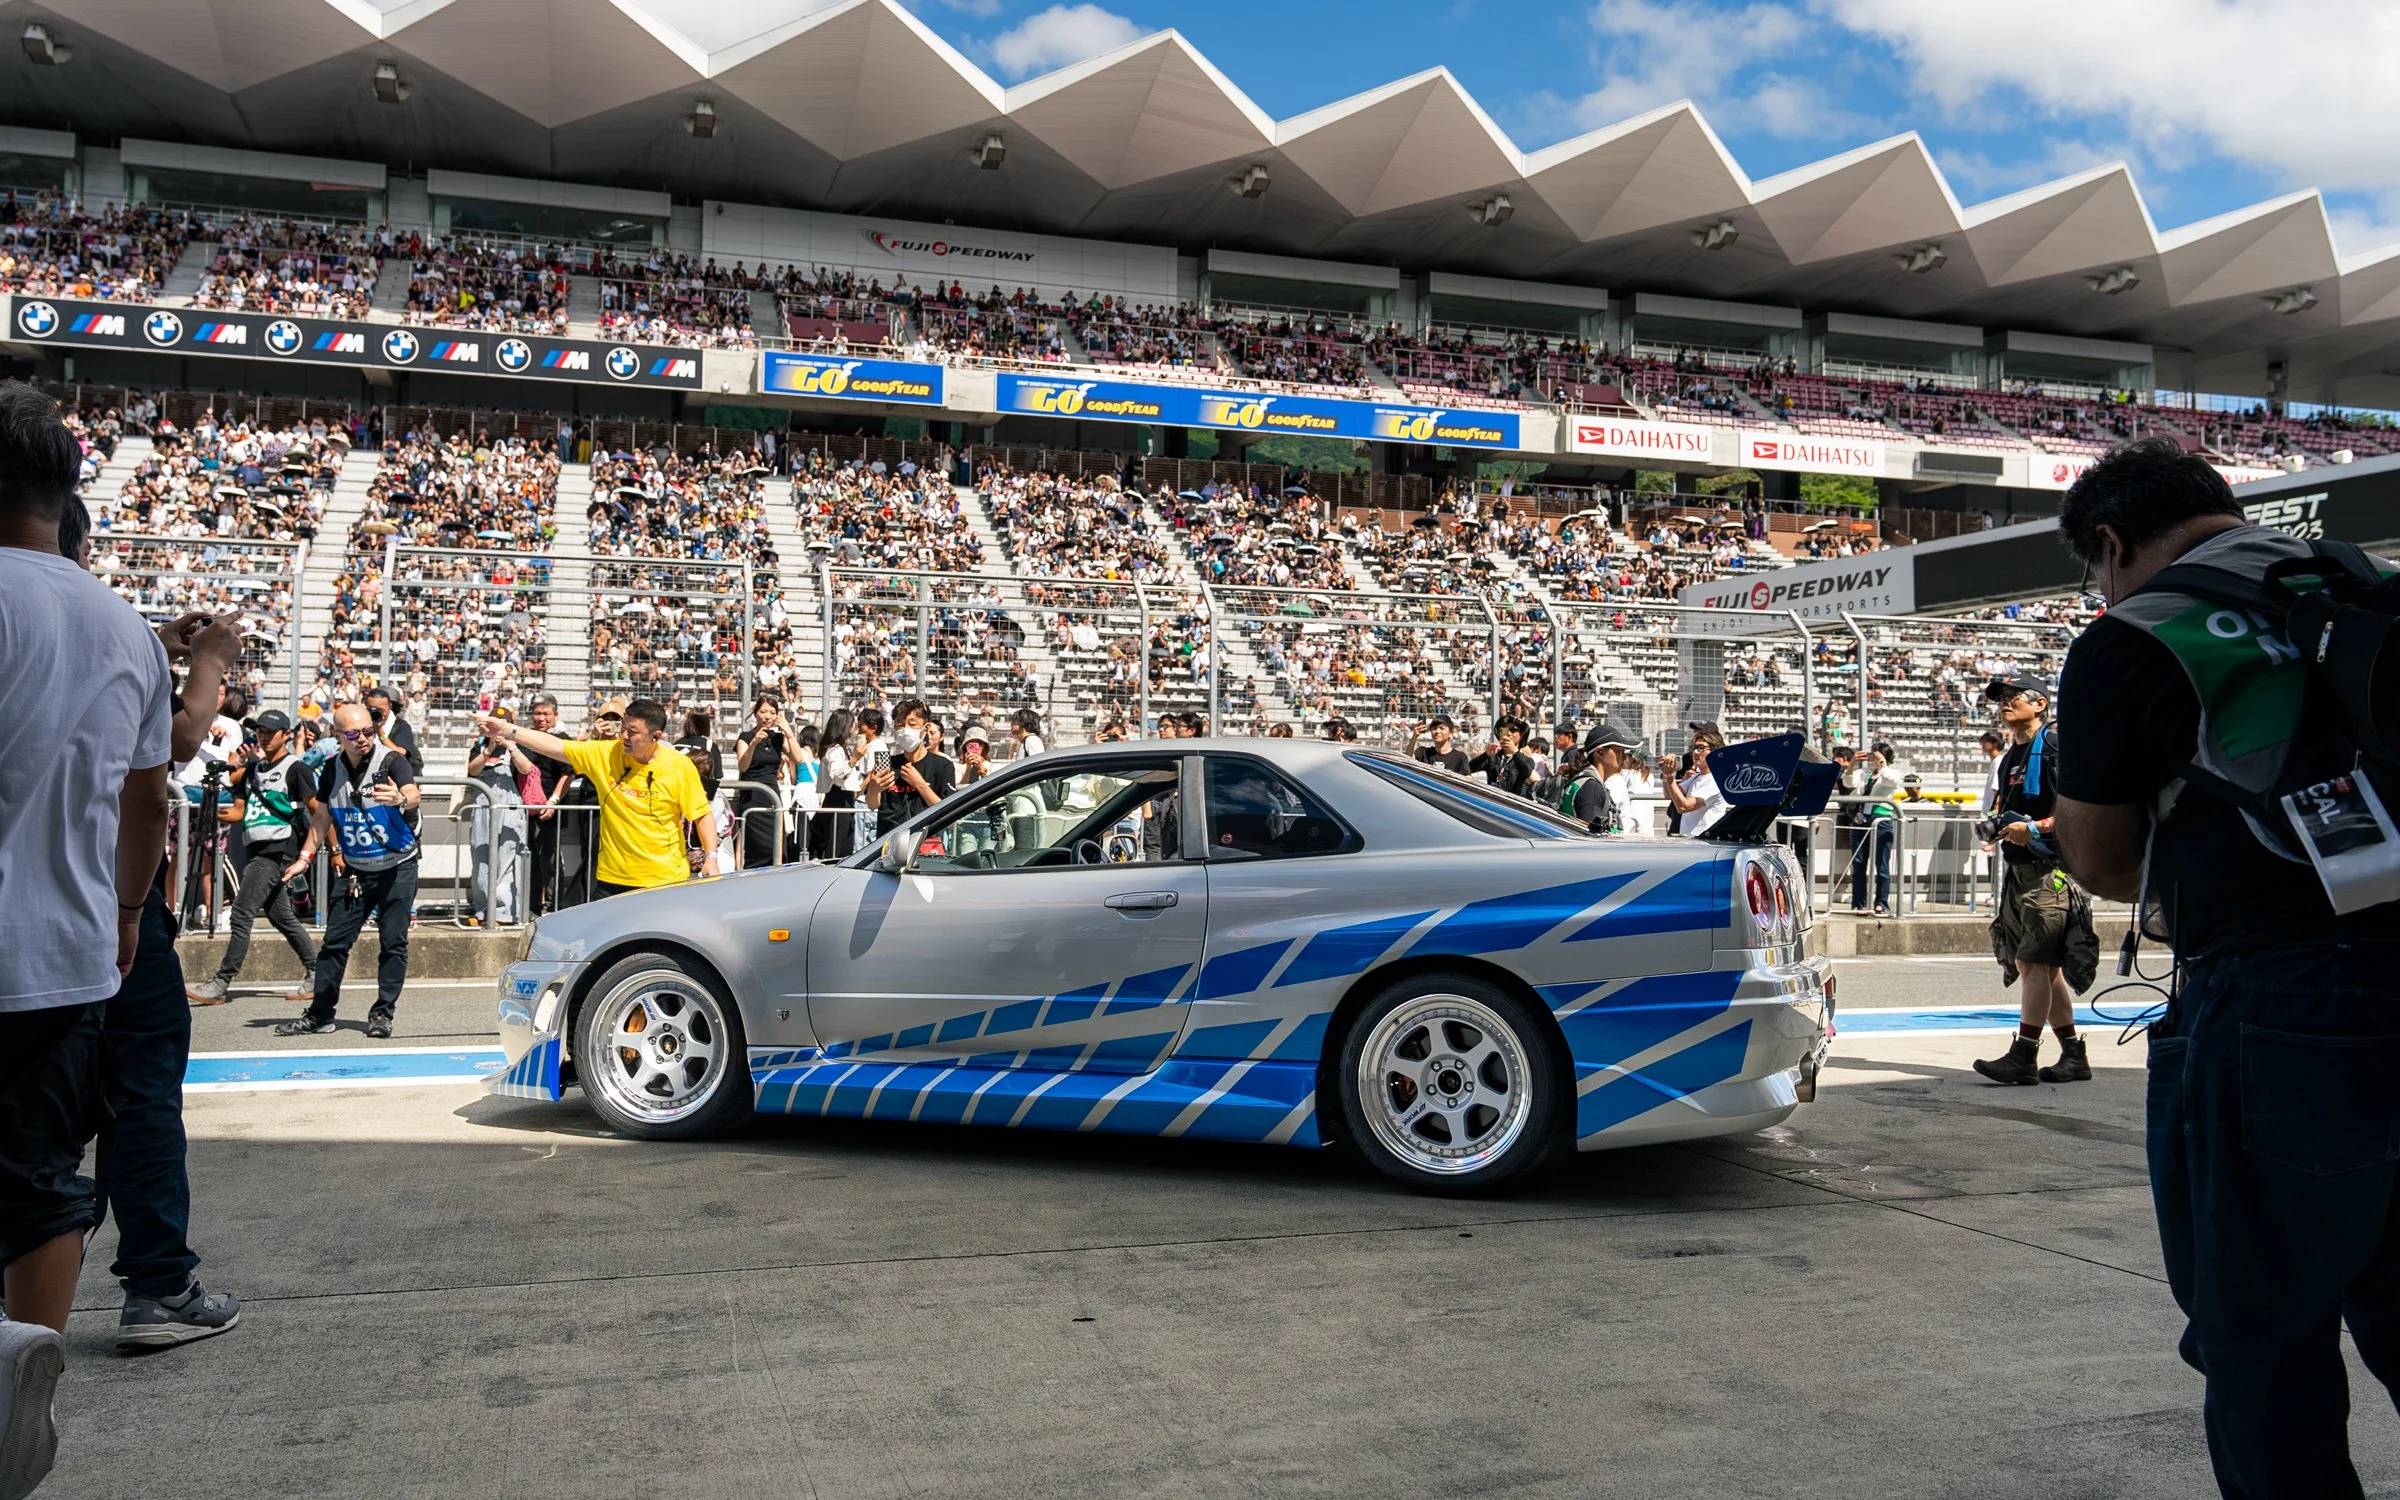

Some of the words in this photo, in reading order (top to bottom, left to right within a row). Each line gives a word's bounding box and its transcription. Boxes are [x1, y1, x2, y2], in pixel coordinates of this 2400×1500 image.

[792, 366, 849, 395] GO
[851, 380, 930, 396] GOODYEAR
[1032, 387, 1084, 415] GO
[1086, 400, 1160, 416] GOODYEAR
[1215, 401, 1265, 428] GO
[1266, 414, 1336, 429] GOODYEAR
[1388, 415, 1435, 441] GO
[1437, 427, 1502, 442] GOODYEAR
[1610, 428, 1708, 452] DAIHATSU
[1783, 444, 1875, 467] DAIHATSU
